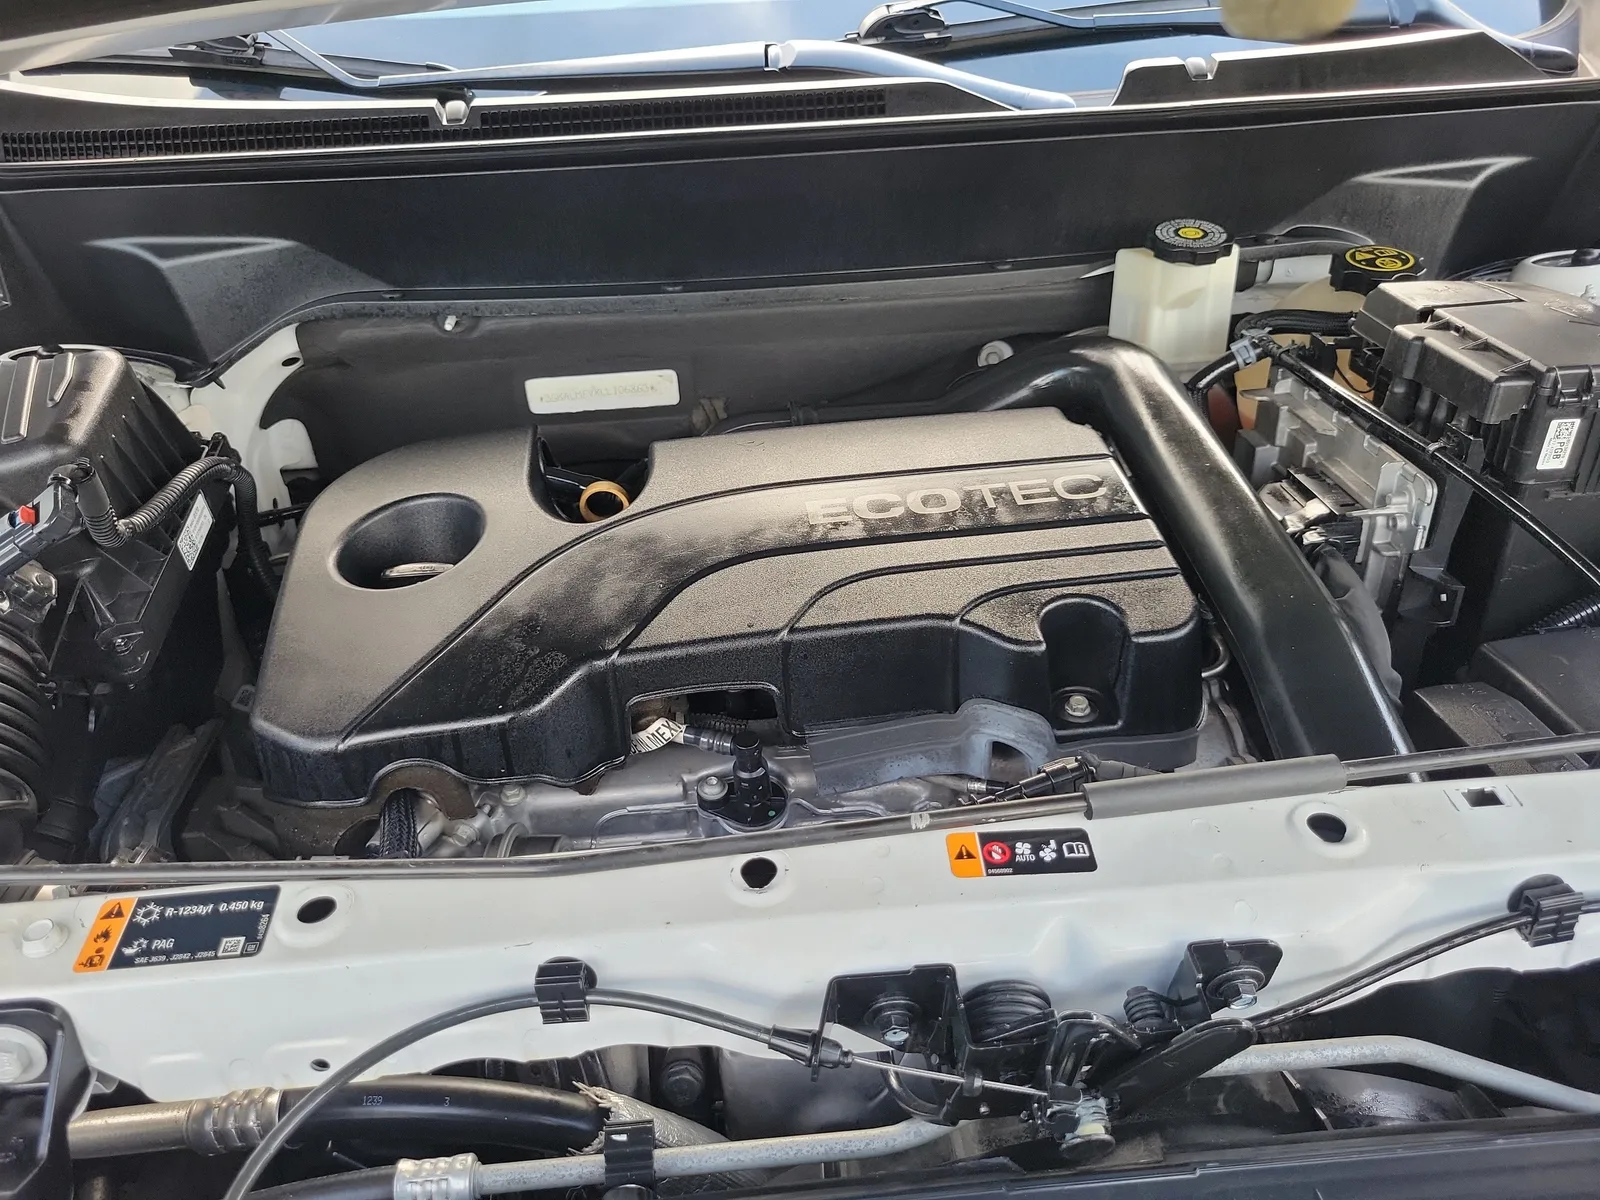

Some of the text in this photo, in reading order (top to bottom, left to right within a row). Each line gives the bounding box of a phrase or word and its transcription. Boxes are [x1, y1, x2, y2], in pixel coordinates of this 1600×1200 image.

[1553, 442, 1565, 459] PGB
[805, 474, 1106, 525] ECOTEC
[1015, 854, 1036, 862] AUTO
[165, 900, 264, 916] R-1234yf 0.450 kg
[152, 938, 174, 950] PAG
[134, 956, 149, 964] SAE
[362, 1096, 451, 1107] 1239 3
